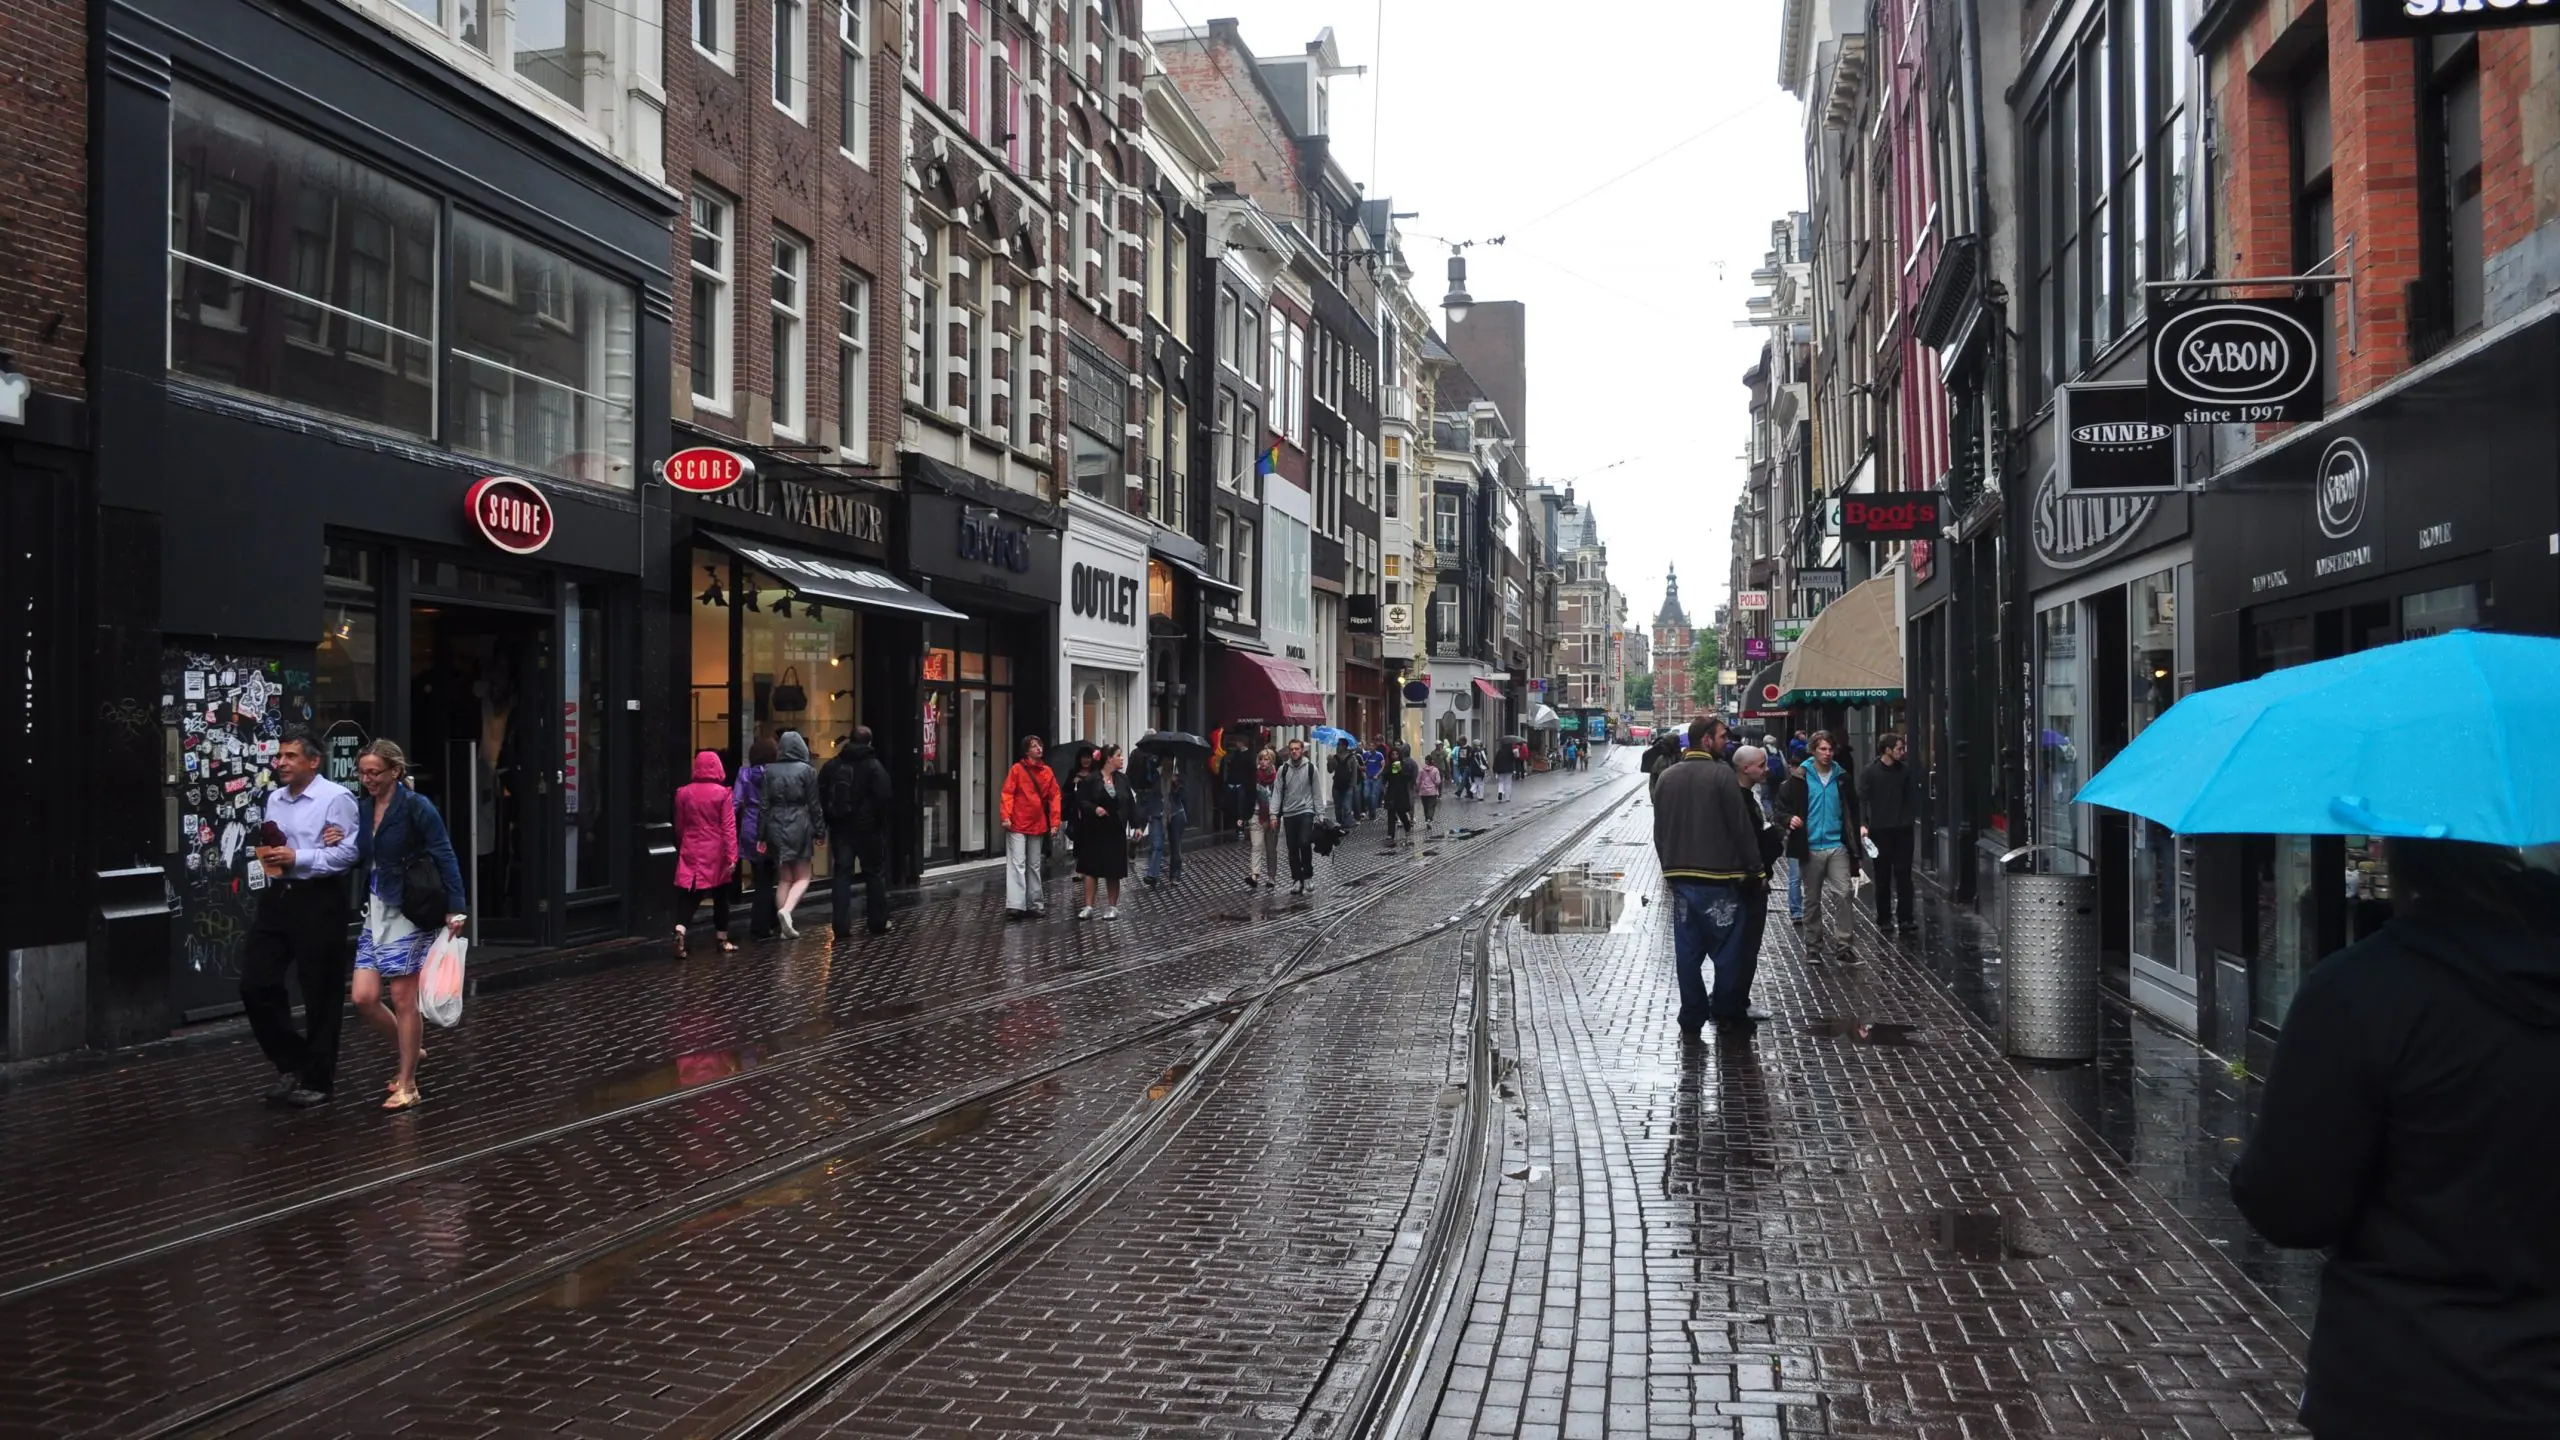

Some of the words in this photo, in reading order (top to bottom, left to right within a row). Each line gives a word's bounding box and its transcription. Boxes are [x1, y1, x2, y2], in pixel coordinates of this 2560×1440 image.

[2187, 339, 2278, 374] SABON
[2183, 407, 2232, 423] since
[2239, 405, 2285, 422] 1997
[2077, 425, 2167, 442] SINNER
[2090, 445, 2153, 453] EYEWEAR
[673, 461, 733, 480] SCORE
[2324, 468, 2359, 510] SABON
[488, 493, 541, 536] SCORE
[781, 479, 884, 543] WARMER
[1844, 500, 1936, 524] Boots
[2418, 521, 2452, 550] ROME
[2314, 545, 2372, 577] AMSTERDAM
[1071, 561, 1139, 627] OUTLET
[1739, 594, 1766, 607] POLEN
[1285, 644, 1306, 660] PANDORA
[1866, 689, 1888, 697] FOOD
[333, 757, 358, 778] 70%
